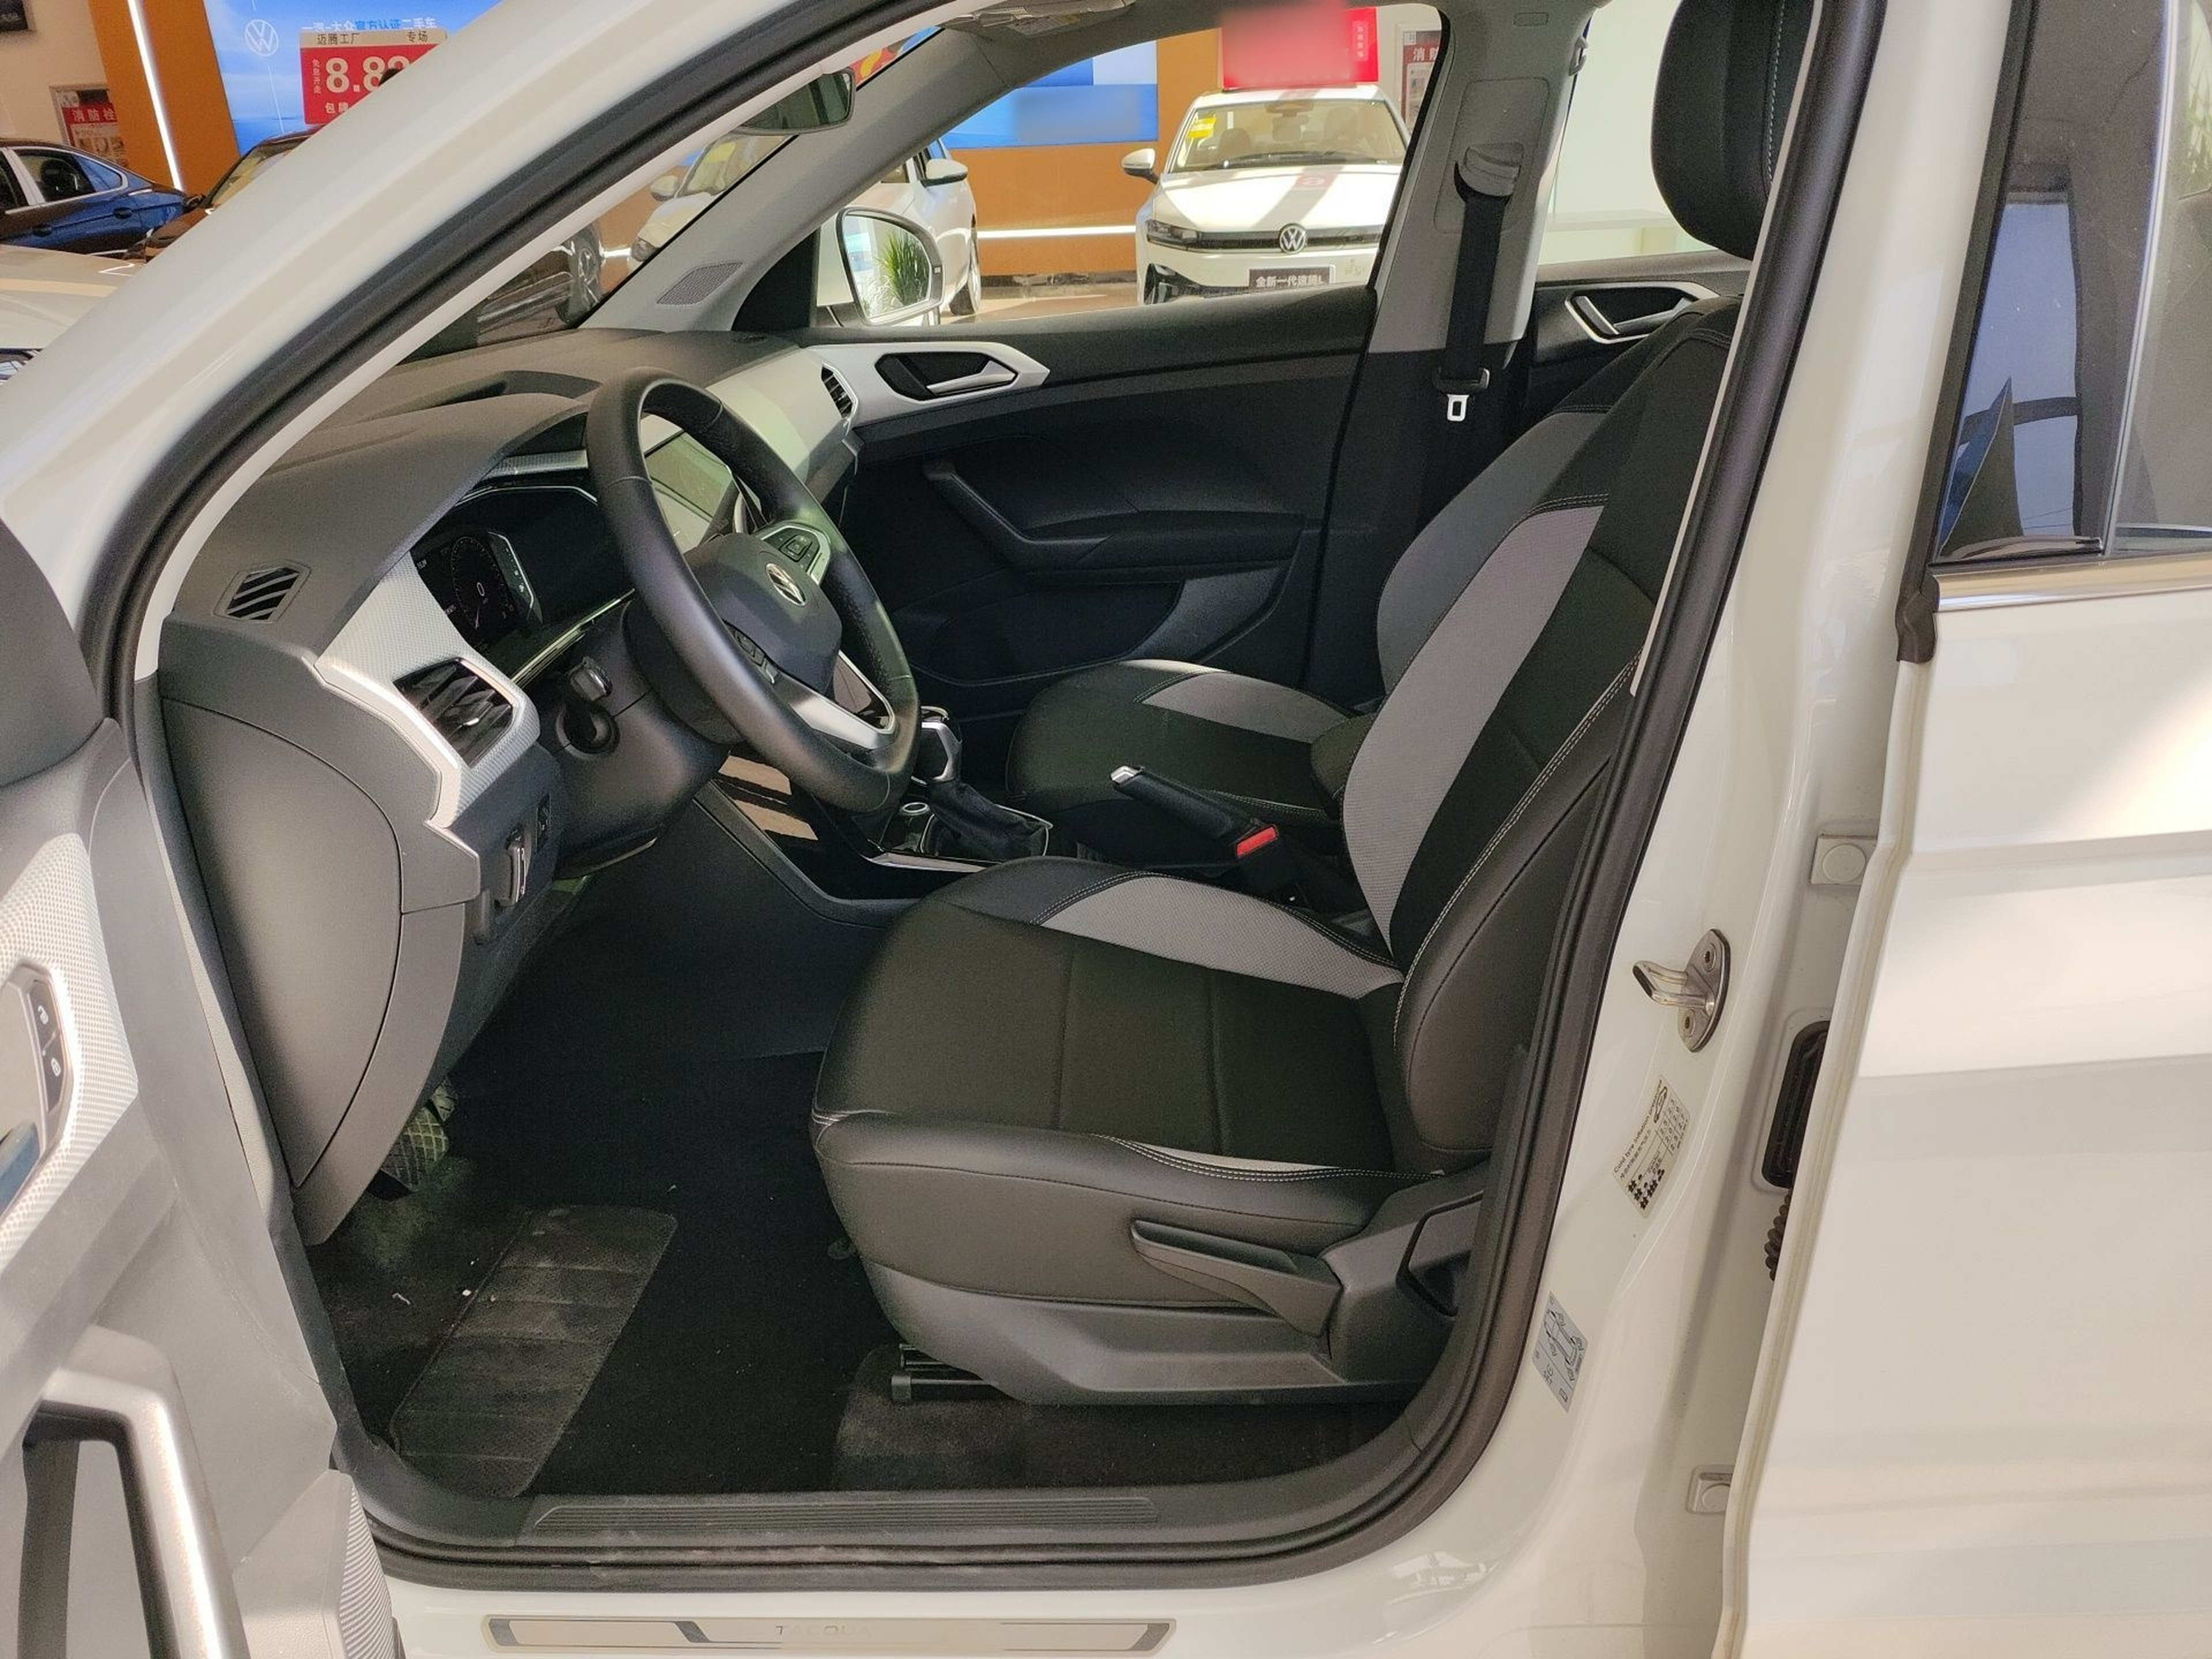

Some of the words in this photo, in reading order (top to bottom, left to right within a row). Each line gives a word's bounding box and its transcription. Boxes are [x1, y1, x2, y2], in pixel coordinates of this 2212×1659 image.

[406, 30, 429, 43] 专场
[72, 107, 116, 122] 消防栓
